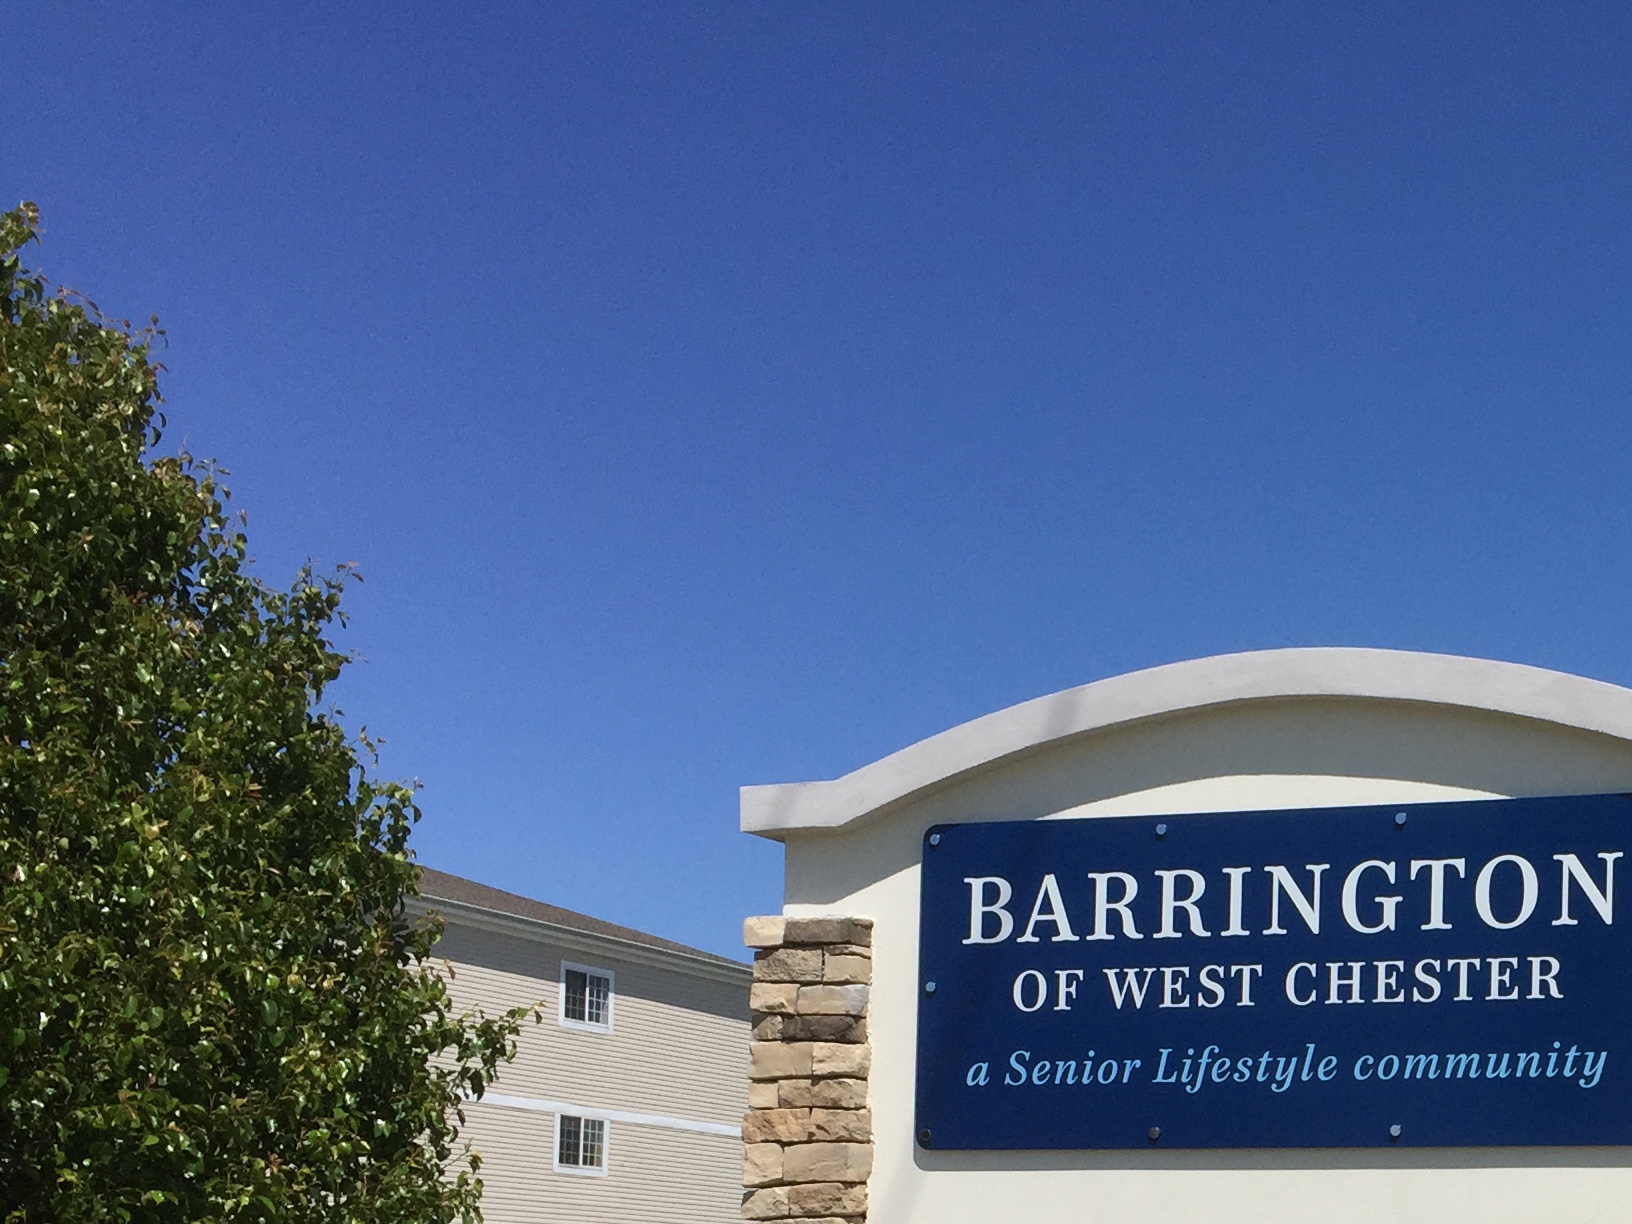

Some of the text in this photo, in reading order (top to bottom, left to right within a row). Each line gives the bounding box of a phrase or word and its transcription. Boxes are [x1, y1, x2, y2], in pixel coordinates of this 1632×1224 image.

[961, 851, 1624, 945] BARRINGTON
[1013, 956, 1564, 1012] OF WEST CHESTER
[966, 1040, 1608, 1094] a Senior Lifestyle community
